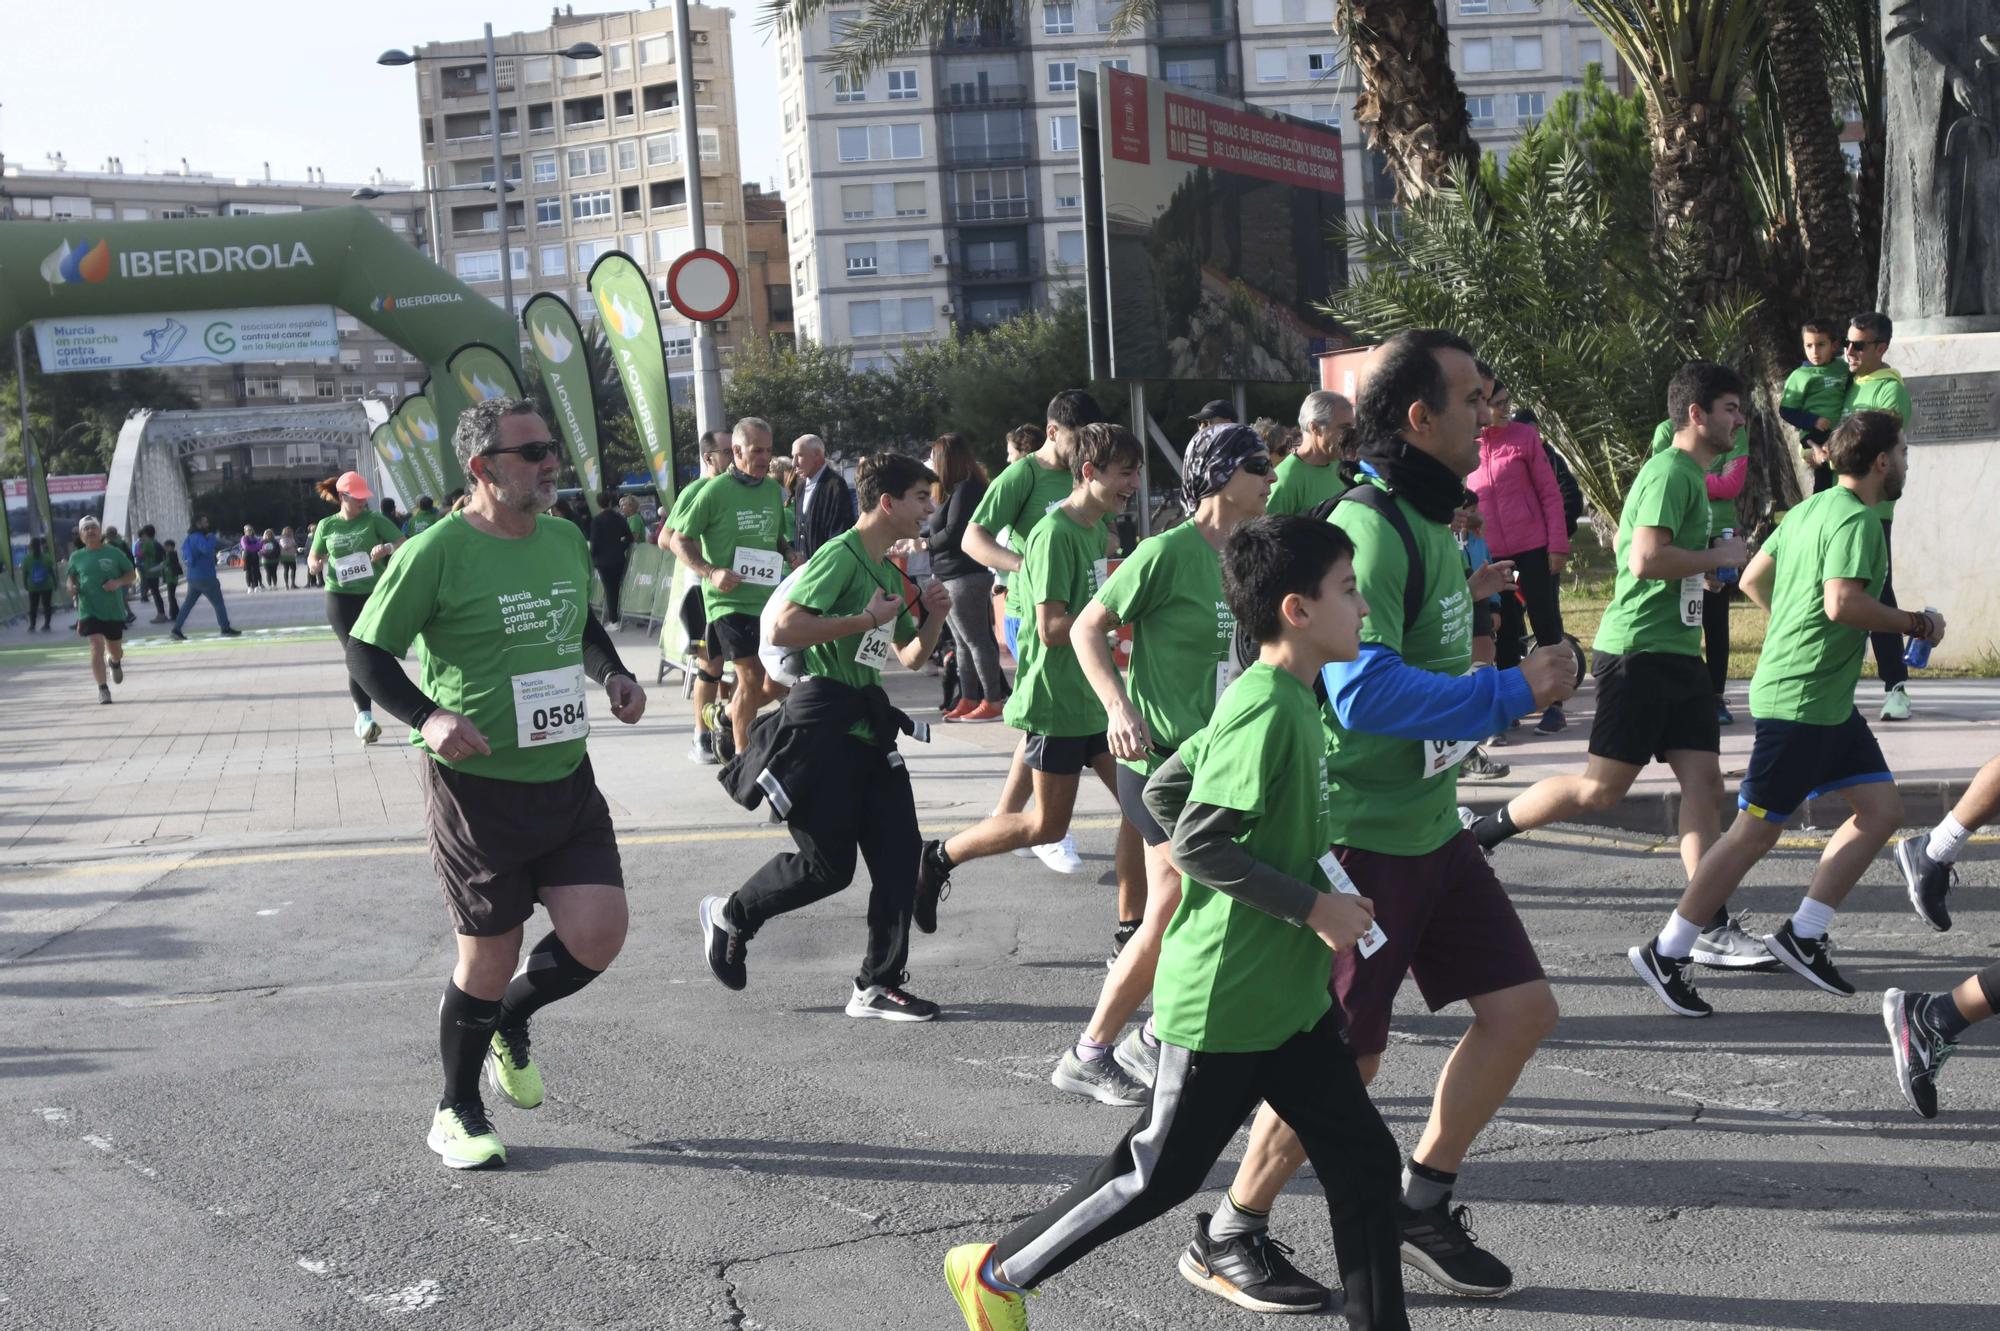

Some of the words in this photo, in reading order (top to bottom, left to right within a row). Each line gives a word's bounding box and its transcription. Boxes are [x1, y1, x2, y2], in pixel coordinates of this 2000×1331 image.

[1169, 102, 1207, 132] MURCIA
[1240, 126, 1250, 141] DE
[1304, 143, 1311, 154] Y
[1310, 144, 1338, 162] MEJORA
[1213, 141, 1224, 156] DE
[1225, 143, 1240, 159] LOS
[1282, 156, 1297, 172] DEL
[119, 241, 314, 277] IBERDROLA
[395, 293, 463, 309] IBERDROLA
[54, 325, 95, 336] Murcia
[242, 333, 270, 341] contra
[55, 338, 70, 346] en
[73, 333, 118, 345] marcha
[255, 342, 264, 350] la
[297, 340, 309, 348] de
[310, 338, 339, 347] Murcia
[56, 346, 95, 356] contra
[58, 355, 69, 366] el
[341, 564, 367, 577] 0586
[740, 564, 774, 579] 0142
[498, 590, 532, 605] Murcia
[501, 605, 516, 615] en
[516, 598, 551, 611] marcha
[504, 611, 535, 624] contra
[505, 624, 516, 634] el
[517, 619, 549, 632] cáncer
[532, 684, 556, 693] marcha
[522, 692, 544, 700] contra
[533, 700, 585, 730] 0584
